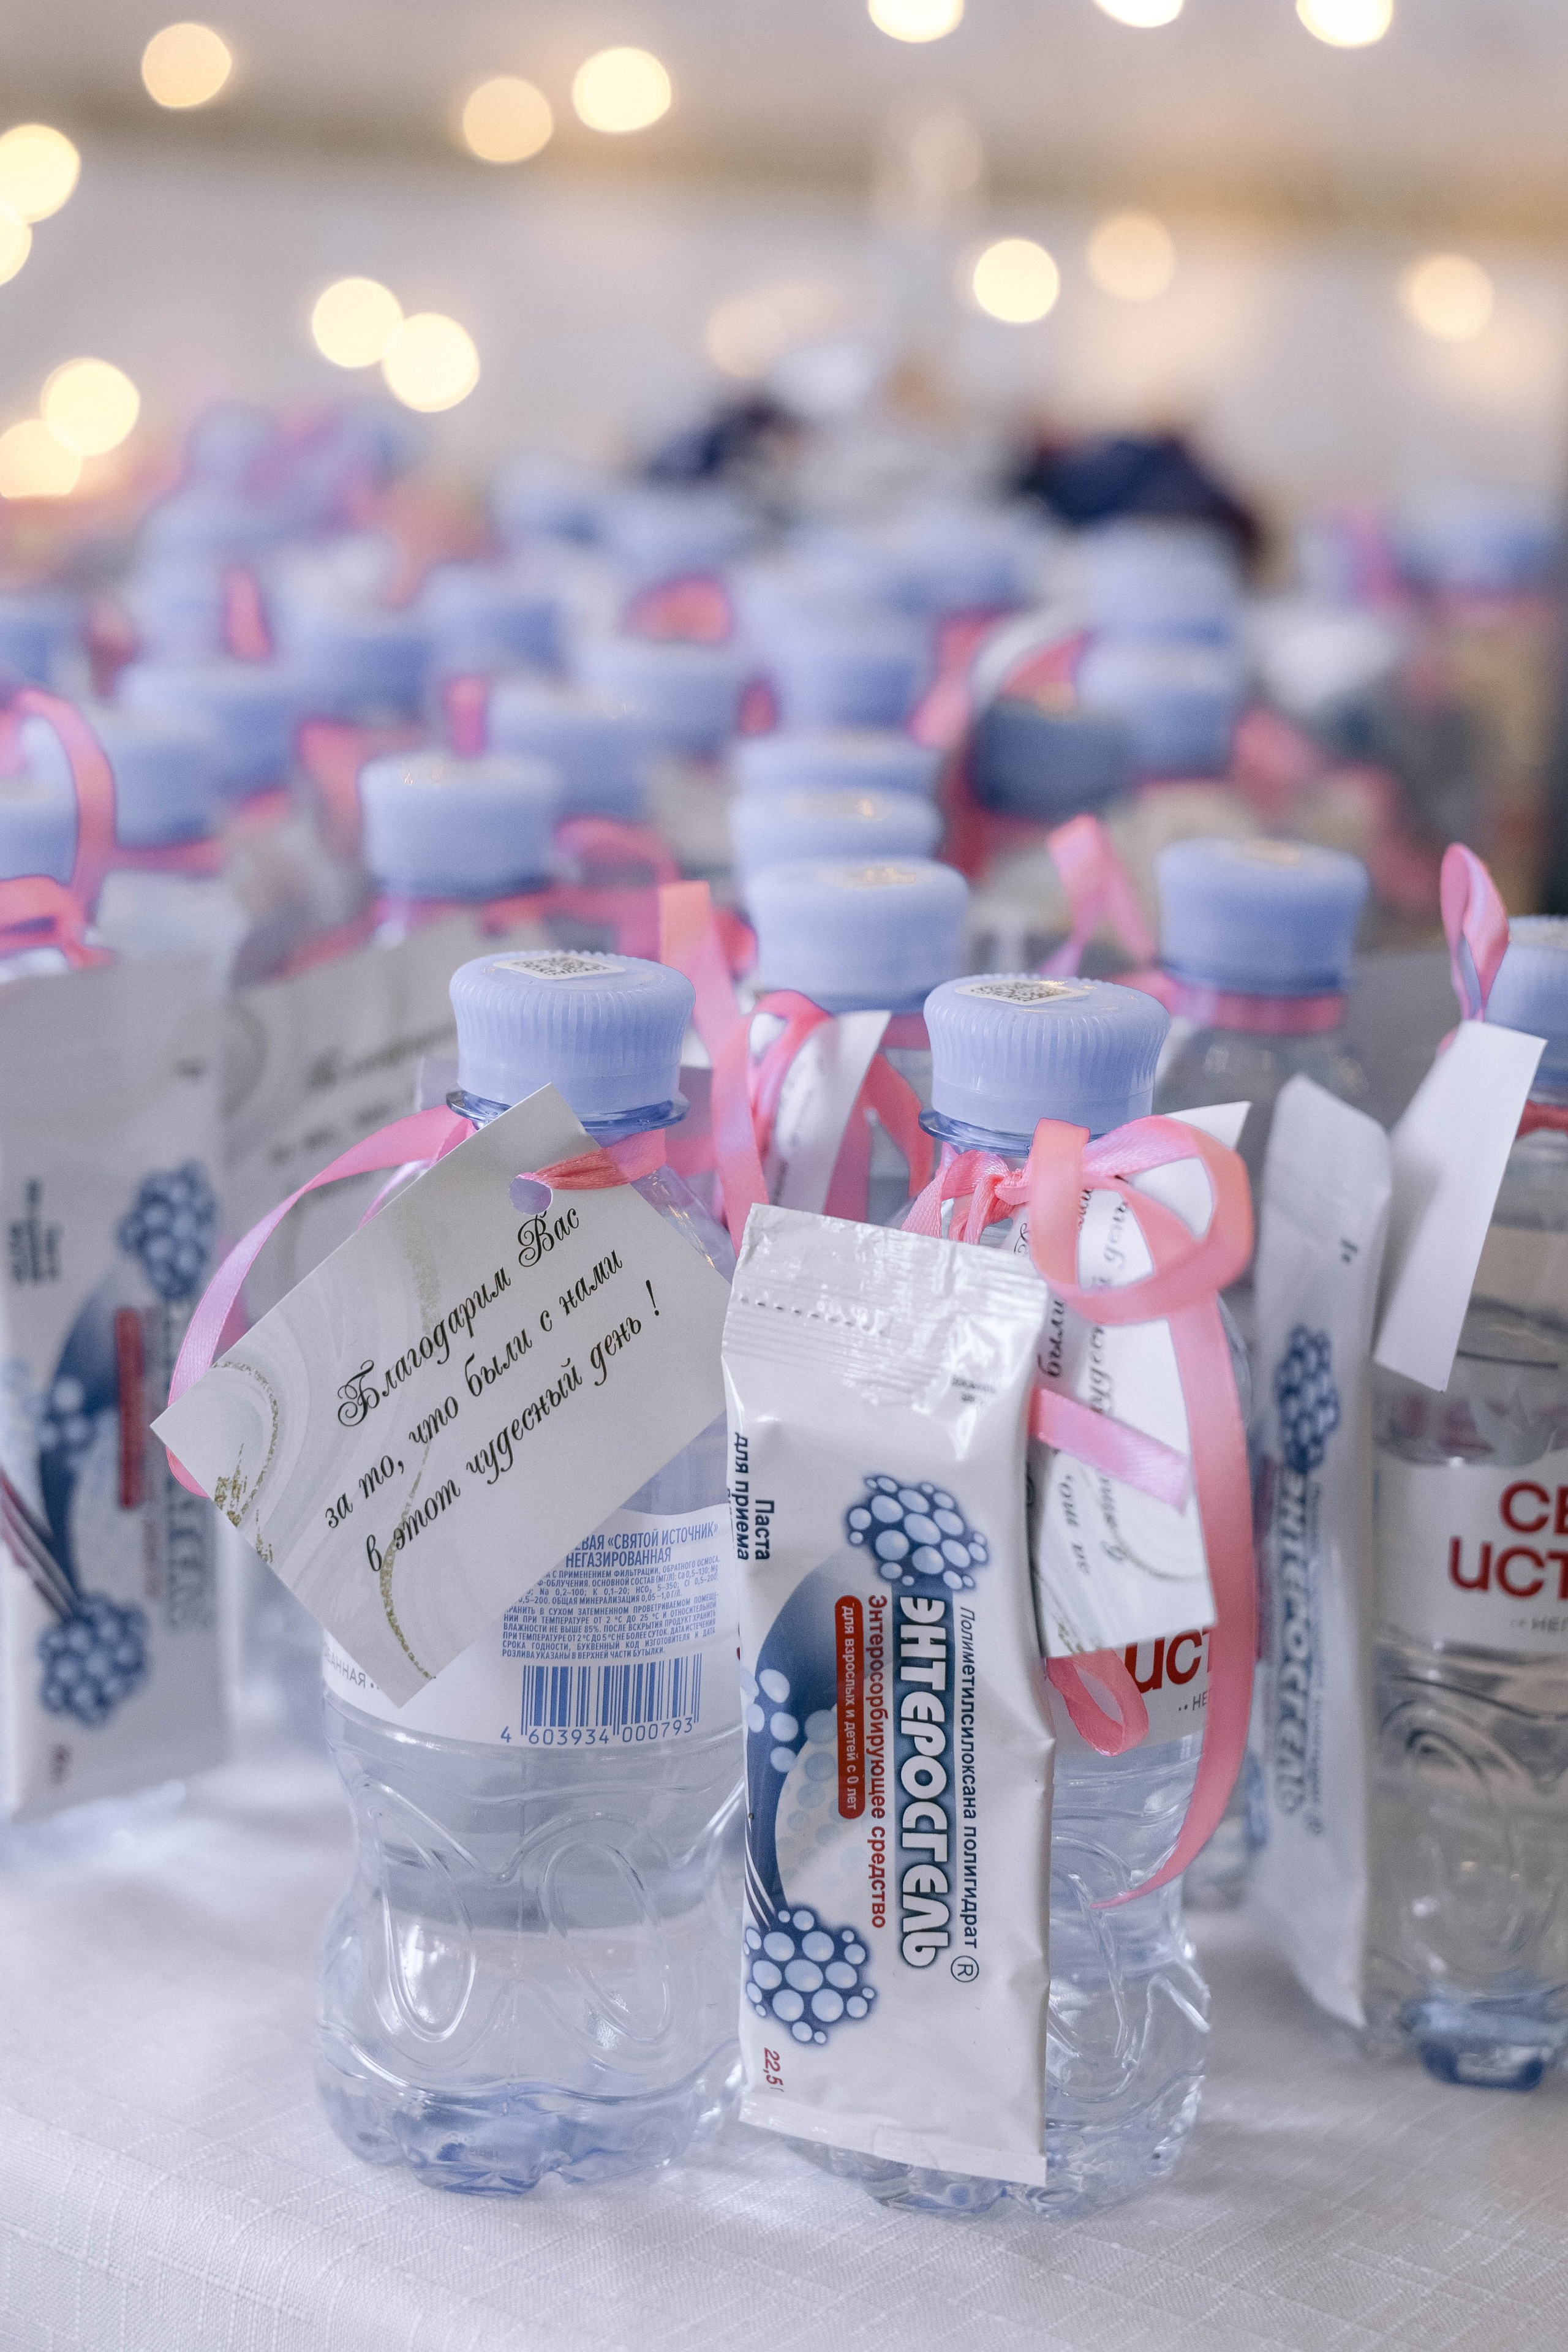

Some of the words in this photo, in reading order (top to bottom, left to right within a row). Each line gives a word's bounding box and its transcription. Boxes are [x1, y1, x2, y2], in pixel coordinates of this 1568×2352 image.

[337, 1267, 511, 1427] Благодарим
[518, 1208, 580, 1267] Вас
[325, 1493, 353, 1528] за
[359, 1455, 404, 1498] то,
[409, 1396, 459, 1443] что
[464, 1329, 532, 1397] были
[540, 1309, 552, 1332] с
[559, 1250, 623, 1315] нами
[367, 1534, 382, 1571] в
[393, 1479, 461, 1551] этот
[467, 1358, 582, 1485] чудесный
[590, 1317, 642, 1385] день
[734, 1432, 748, 1474] для
[575, 1534, 605, 1550] ВАЯ
[608, 1529, 659, 1550] «СВЯТОЙ
[662, 1521, 719, 1545] ИСТОЧНИК»
[731, 1480, 749, 1561] приема
[755, 1499, 775, 1560] Паста
[559, 1570, 612, 1578] ПРИМЕНЕНИЕМ
[614, 1567, 661, 1577] ФИЛЬТРАЦИИ,
[663, 1561, 696, 1574] ОБРАТНОГО
[565, 1547, 671, 1568] НЕГАЗИРОВАННАЯ
[592, 1577, 629, 1587] ОСНОВНОЙ
[631, 1576, 655, 1586] СОСТАВ
[507, 1605, 535, 1614] РАНИТЬ
[578, 1607, 629, 1615] ЗАТЕМНЕННОМ
[633, 1598, 690, 1613] ПРОВЕТРИВАЕМОМ
[552, 1597, 578, 1606] ОБЩАЯ
[579, 1595, 640, 1605] МИНЕРАЛИЗАЦИЯ
[503, 1623, 547, 1632] ВЛАЖНОСТИ
[604, 1624, 627, 1632] ПОСЛЕ
[628, 1619, 663, 1631] ВСКРЫТИЯ
[665, 1615, 692, 1627] ПРОДУКТ
[693, 1610, 716, 1621] ХРАНИТЬ
[541, 1616, 589, 1624] ТЕМПЕРАТУРЕ
[842, 1604, 854, 1635] для
[502, 1640, 526, 1649] СРОКА
[532, 1642, 571, 1651] ГОДНОСТИ,
[577, 1641, 620, 1651] БУКВЕННЫЙ
[645, 1633, 690, 1647] ИЗГОТОВИТЕЛЯ
[518, 1633, 568, 1642] ТЕМПЕРАТУРЕ
[626, 1631, 647, 1640] БОЛЕЕ
[502, 1649, 535, 1658] РОЗЛИВА
[536, 1651, 570, 1660] УКАЗАНЫ
[578, 1649, 609, 1659] ВЕРХНЕЙ
[610, 1650, 631, 1659] ЧАСТИ
[844, 1637, 856, 1706] взрослых
[845, 1709, 855, 1717] и
[865, 1595, 888, 1819] Энтеросорбирующее
[960, 1607, 977, 1819] Полиметилсилоксана
[500, 1726, 512, 1743] 4
[528, 1728, 609, 1746] 603934
[622, 1717, 693, 1743] 000793
[844, 1722, 859, 1762] детей
[900, 1596, 950, 1967] ЭНТЕРОСГЕЛЬ
[846, 1787, 857, 1810] лет
[867, 1826, 886, 1928] средство
[960, 1826, 977, 1948] полигидрат
[763, 2047, 784, 2086] 22,5
